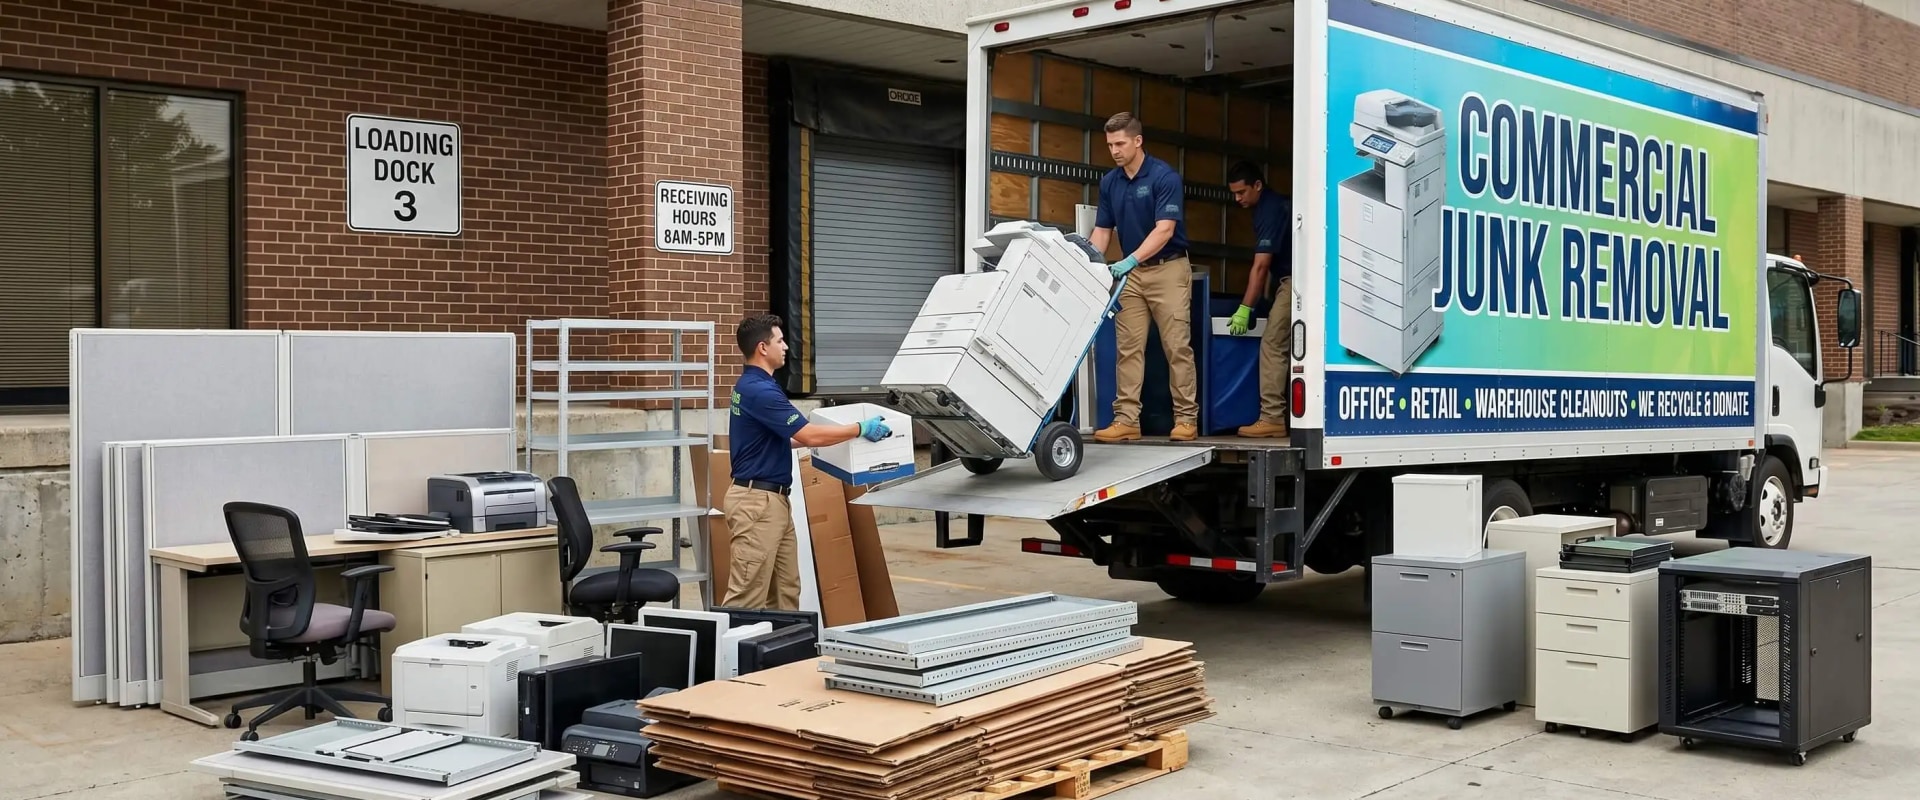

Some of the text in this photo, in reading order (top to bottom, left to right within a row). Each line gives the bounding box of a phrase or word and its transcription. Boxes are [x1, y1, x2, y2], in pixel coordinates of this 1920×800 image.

[355, 127, 453, 156] LOADING
[374, 158, 435, 184] DOCK
[1459, 95, 1717, 234] COMMERCIAL
[393, 190, 418, 222] 3
[660, 188, 728, 208] RECEIVING
[672, 209, 717, 226] HOURS
[664, 229, 725, 247] 8AM-5PM
[1433, 208, 1729, 330] JUNK REMOVAL
[1339, 385, 1749, 420] OFFICE RETAIL WAREHOUSE CLEANOUTS WE RECYCLE & DONATE
